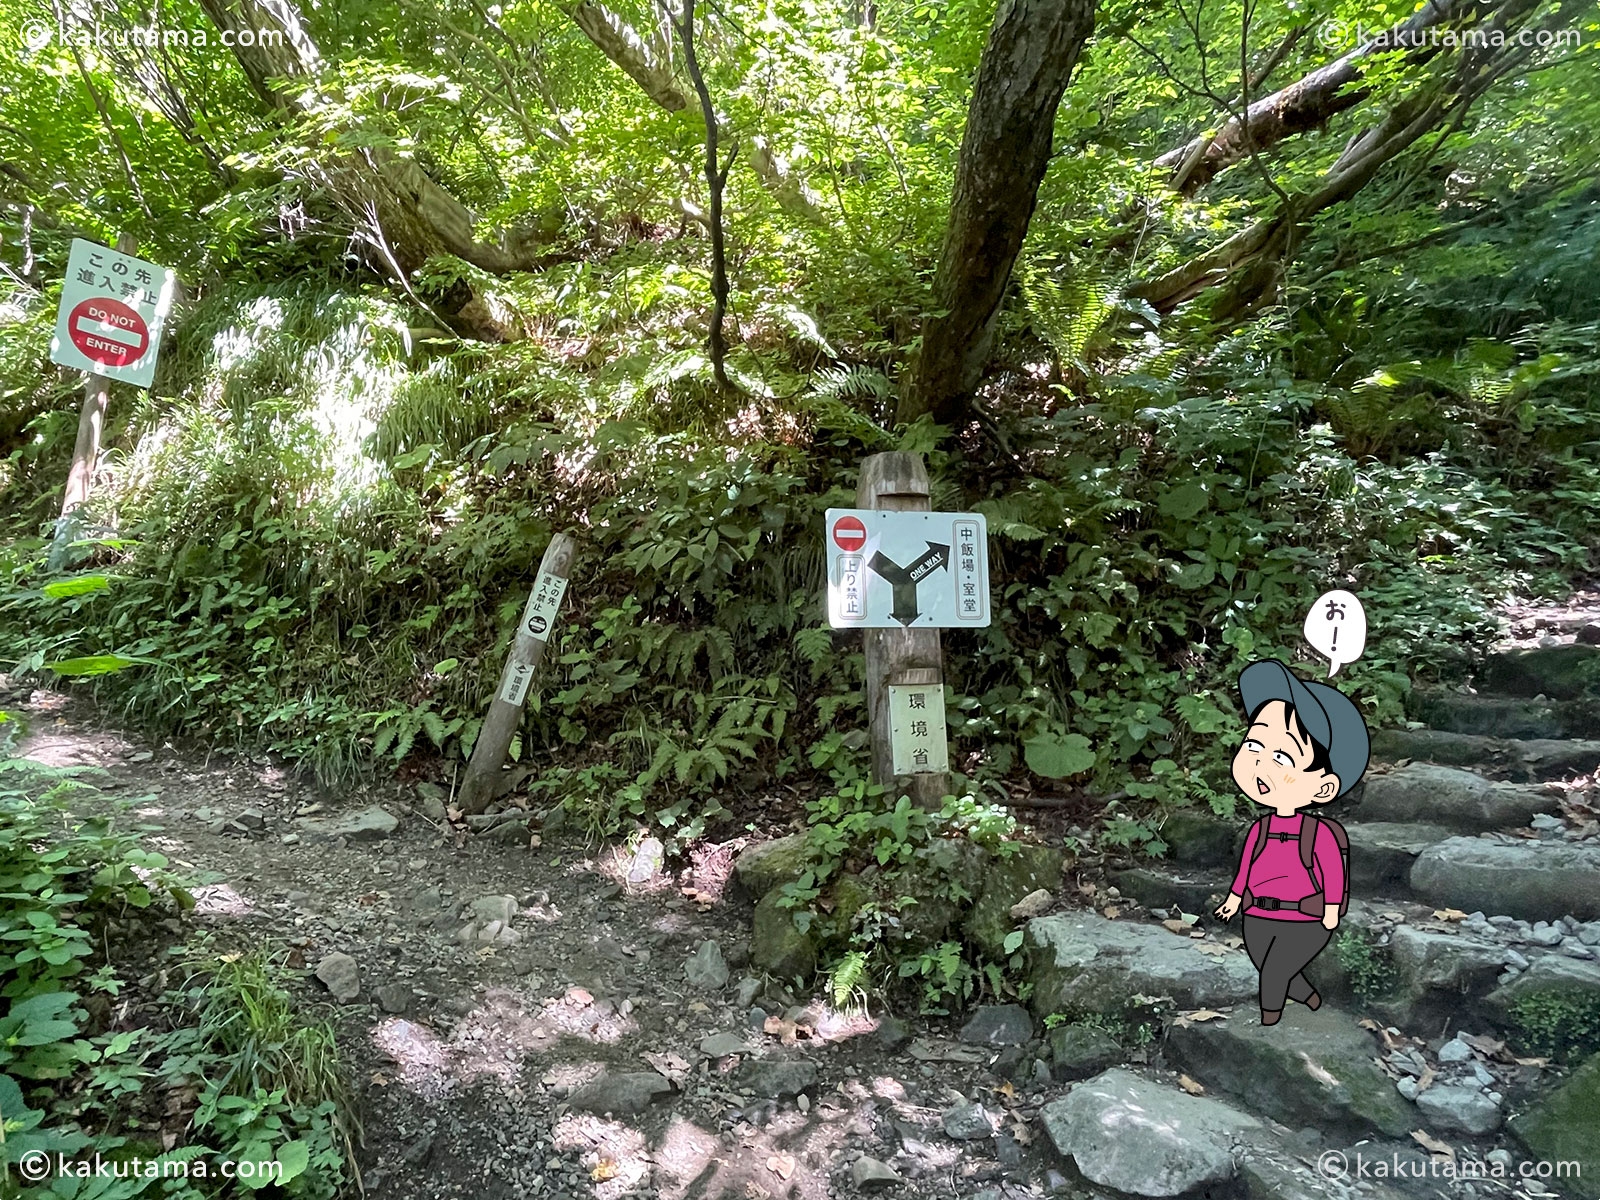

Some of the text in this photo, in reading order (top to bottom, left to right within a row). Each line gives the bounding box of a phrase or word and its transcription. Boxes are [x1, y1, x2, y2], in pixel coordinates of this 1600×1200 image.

[88, 252, 152, 286] この先
[76, 267, 158, 306] 進入禁止
[88, 307, 136, 329] DO NOT
[86, 337, 127, 357] ENTER
[909, 551, 944, 580] ONE WAY
[960, 527, 977, 613] 中飯場・室堂
[547, 580, 562, 607] この先
[844, 560, 859, 614] 上り禁止
[908, 692, 929, 765] 環境省
